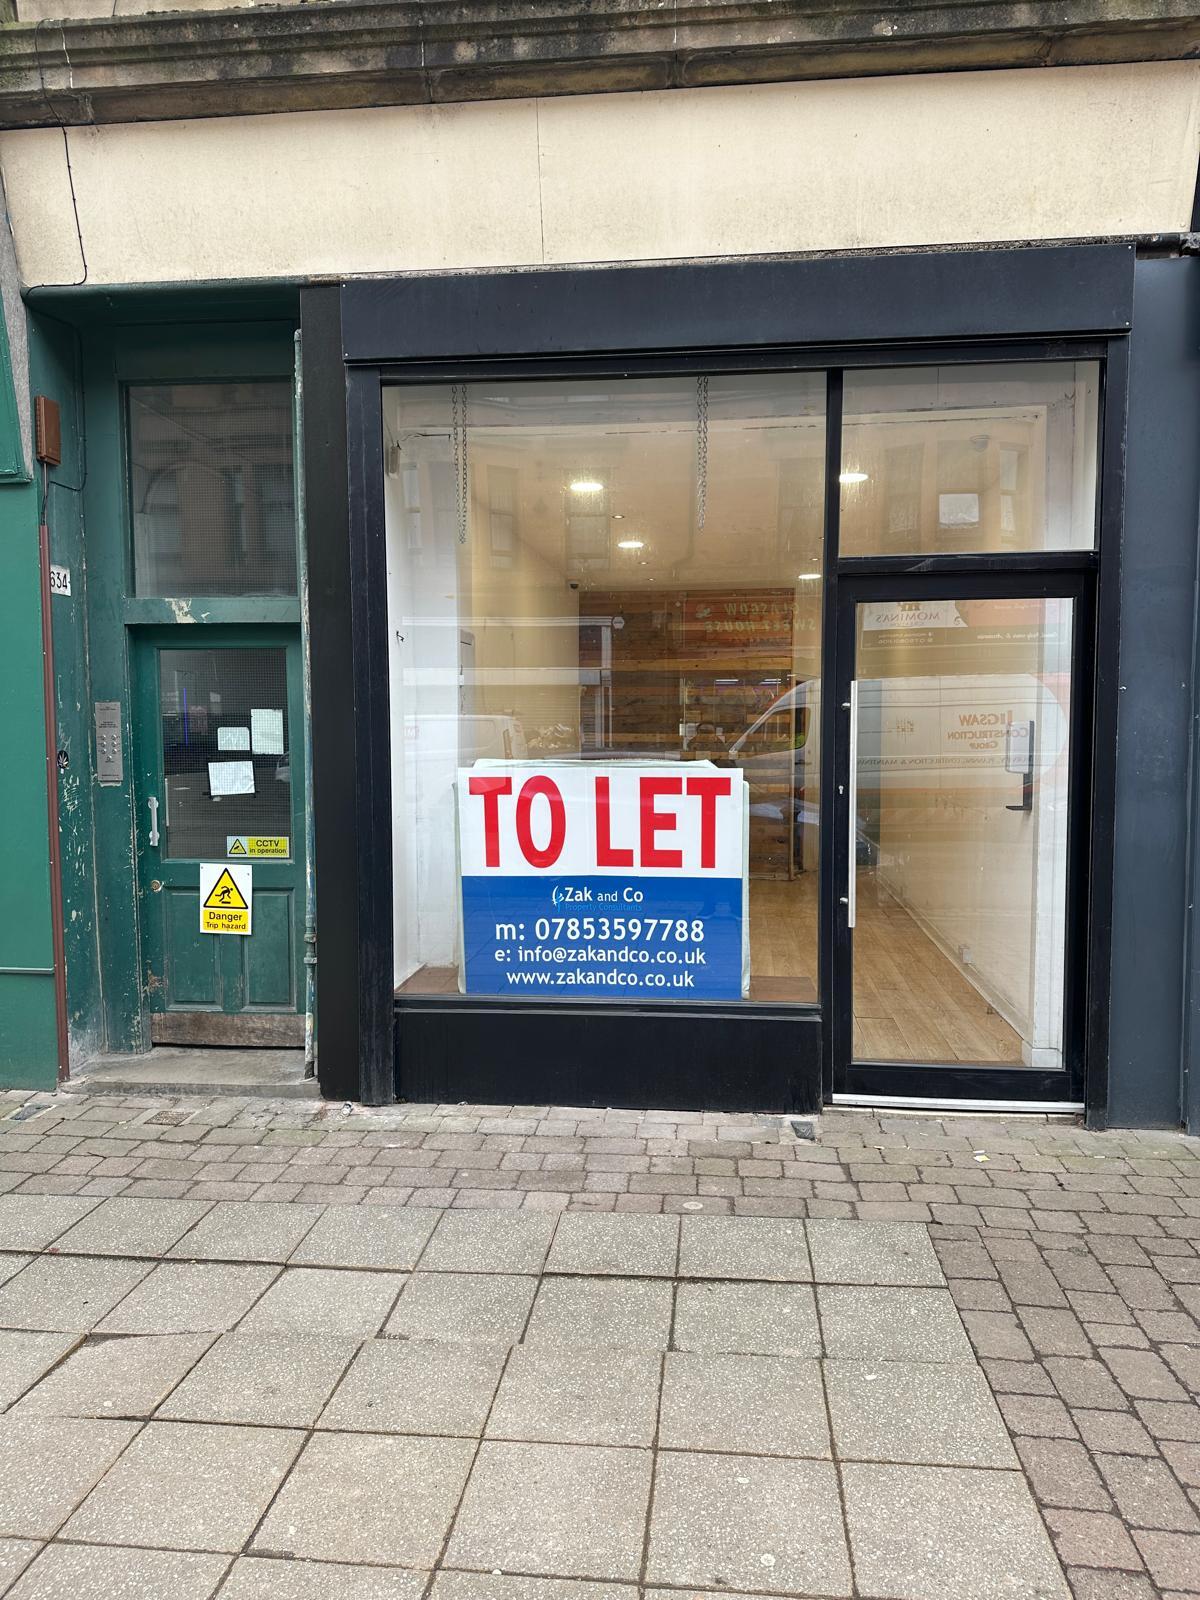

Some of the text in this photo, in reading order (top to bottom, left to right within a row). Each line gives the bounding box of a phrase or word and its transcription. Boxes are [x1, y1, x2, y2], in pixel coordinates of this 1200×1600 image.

[49, 571, 68, 590] 634
[468, 775, 732, 869] TO LET
[256, 839, 280, 847] CCTV
[564, 887, 644, 903] Zak and Co
[565, 902, 642, 912] Property Consultants
[209, 911, 242, 922] Danger
[206, 921, 246, 930] Trip hazard
[495, 918, 705, 942] m: 07853597788
[495, 945, 706, 965] e: info@zakandco.co.uk
[506, 968, 695, 988] www.zakandco.co.uk
